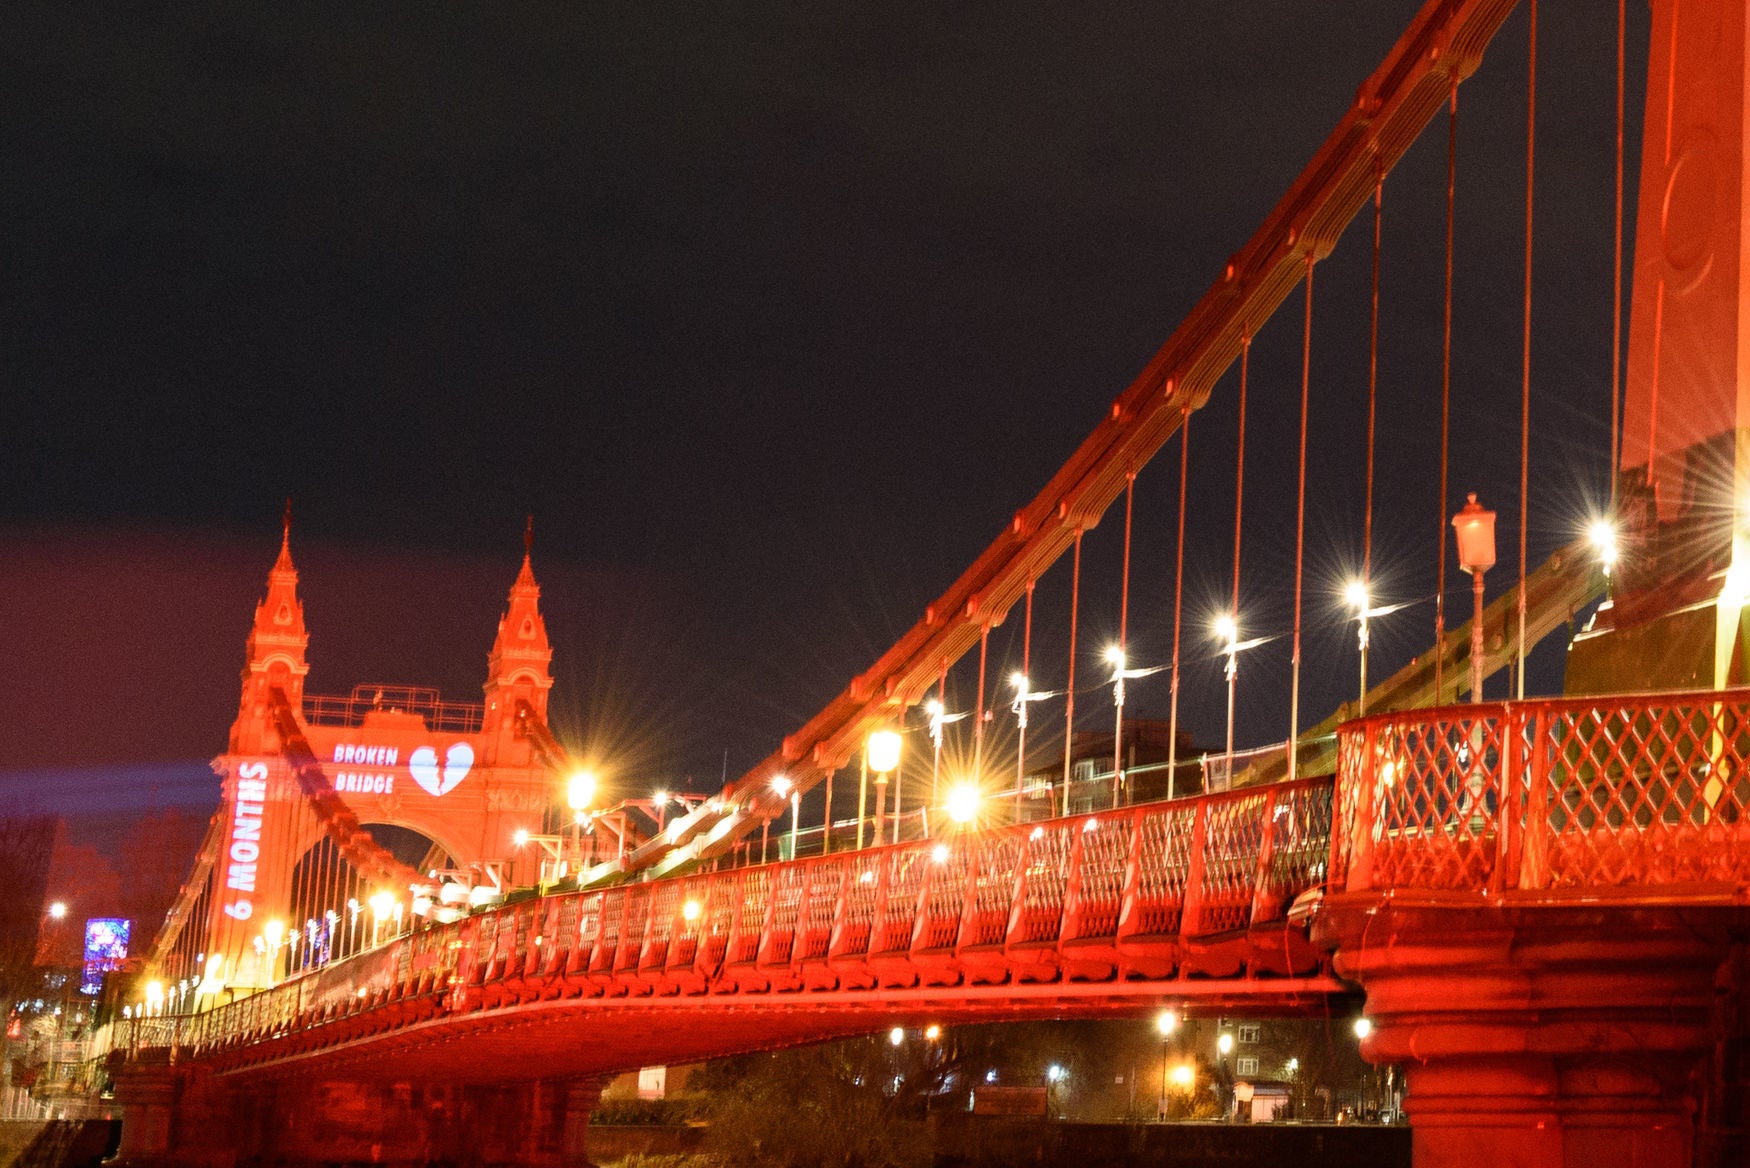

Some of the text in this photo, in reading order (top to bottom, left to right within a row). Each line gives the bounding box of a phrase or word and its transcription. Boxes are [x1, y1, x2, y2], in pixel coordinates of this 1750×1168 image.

[334, 745, 398, 765] BROKEN
[335, 774, 393, 793] BRIDGE
[224, 762, 268, 921] 6 MONTHS
